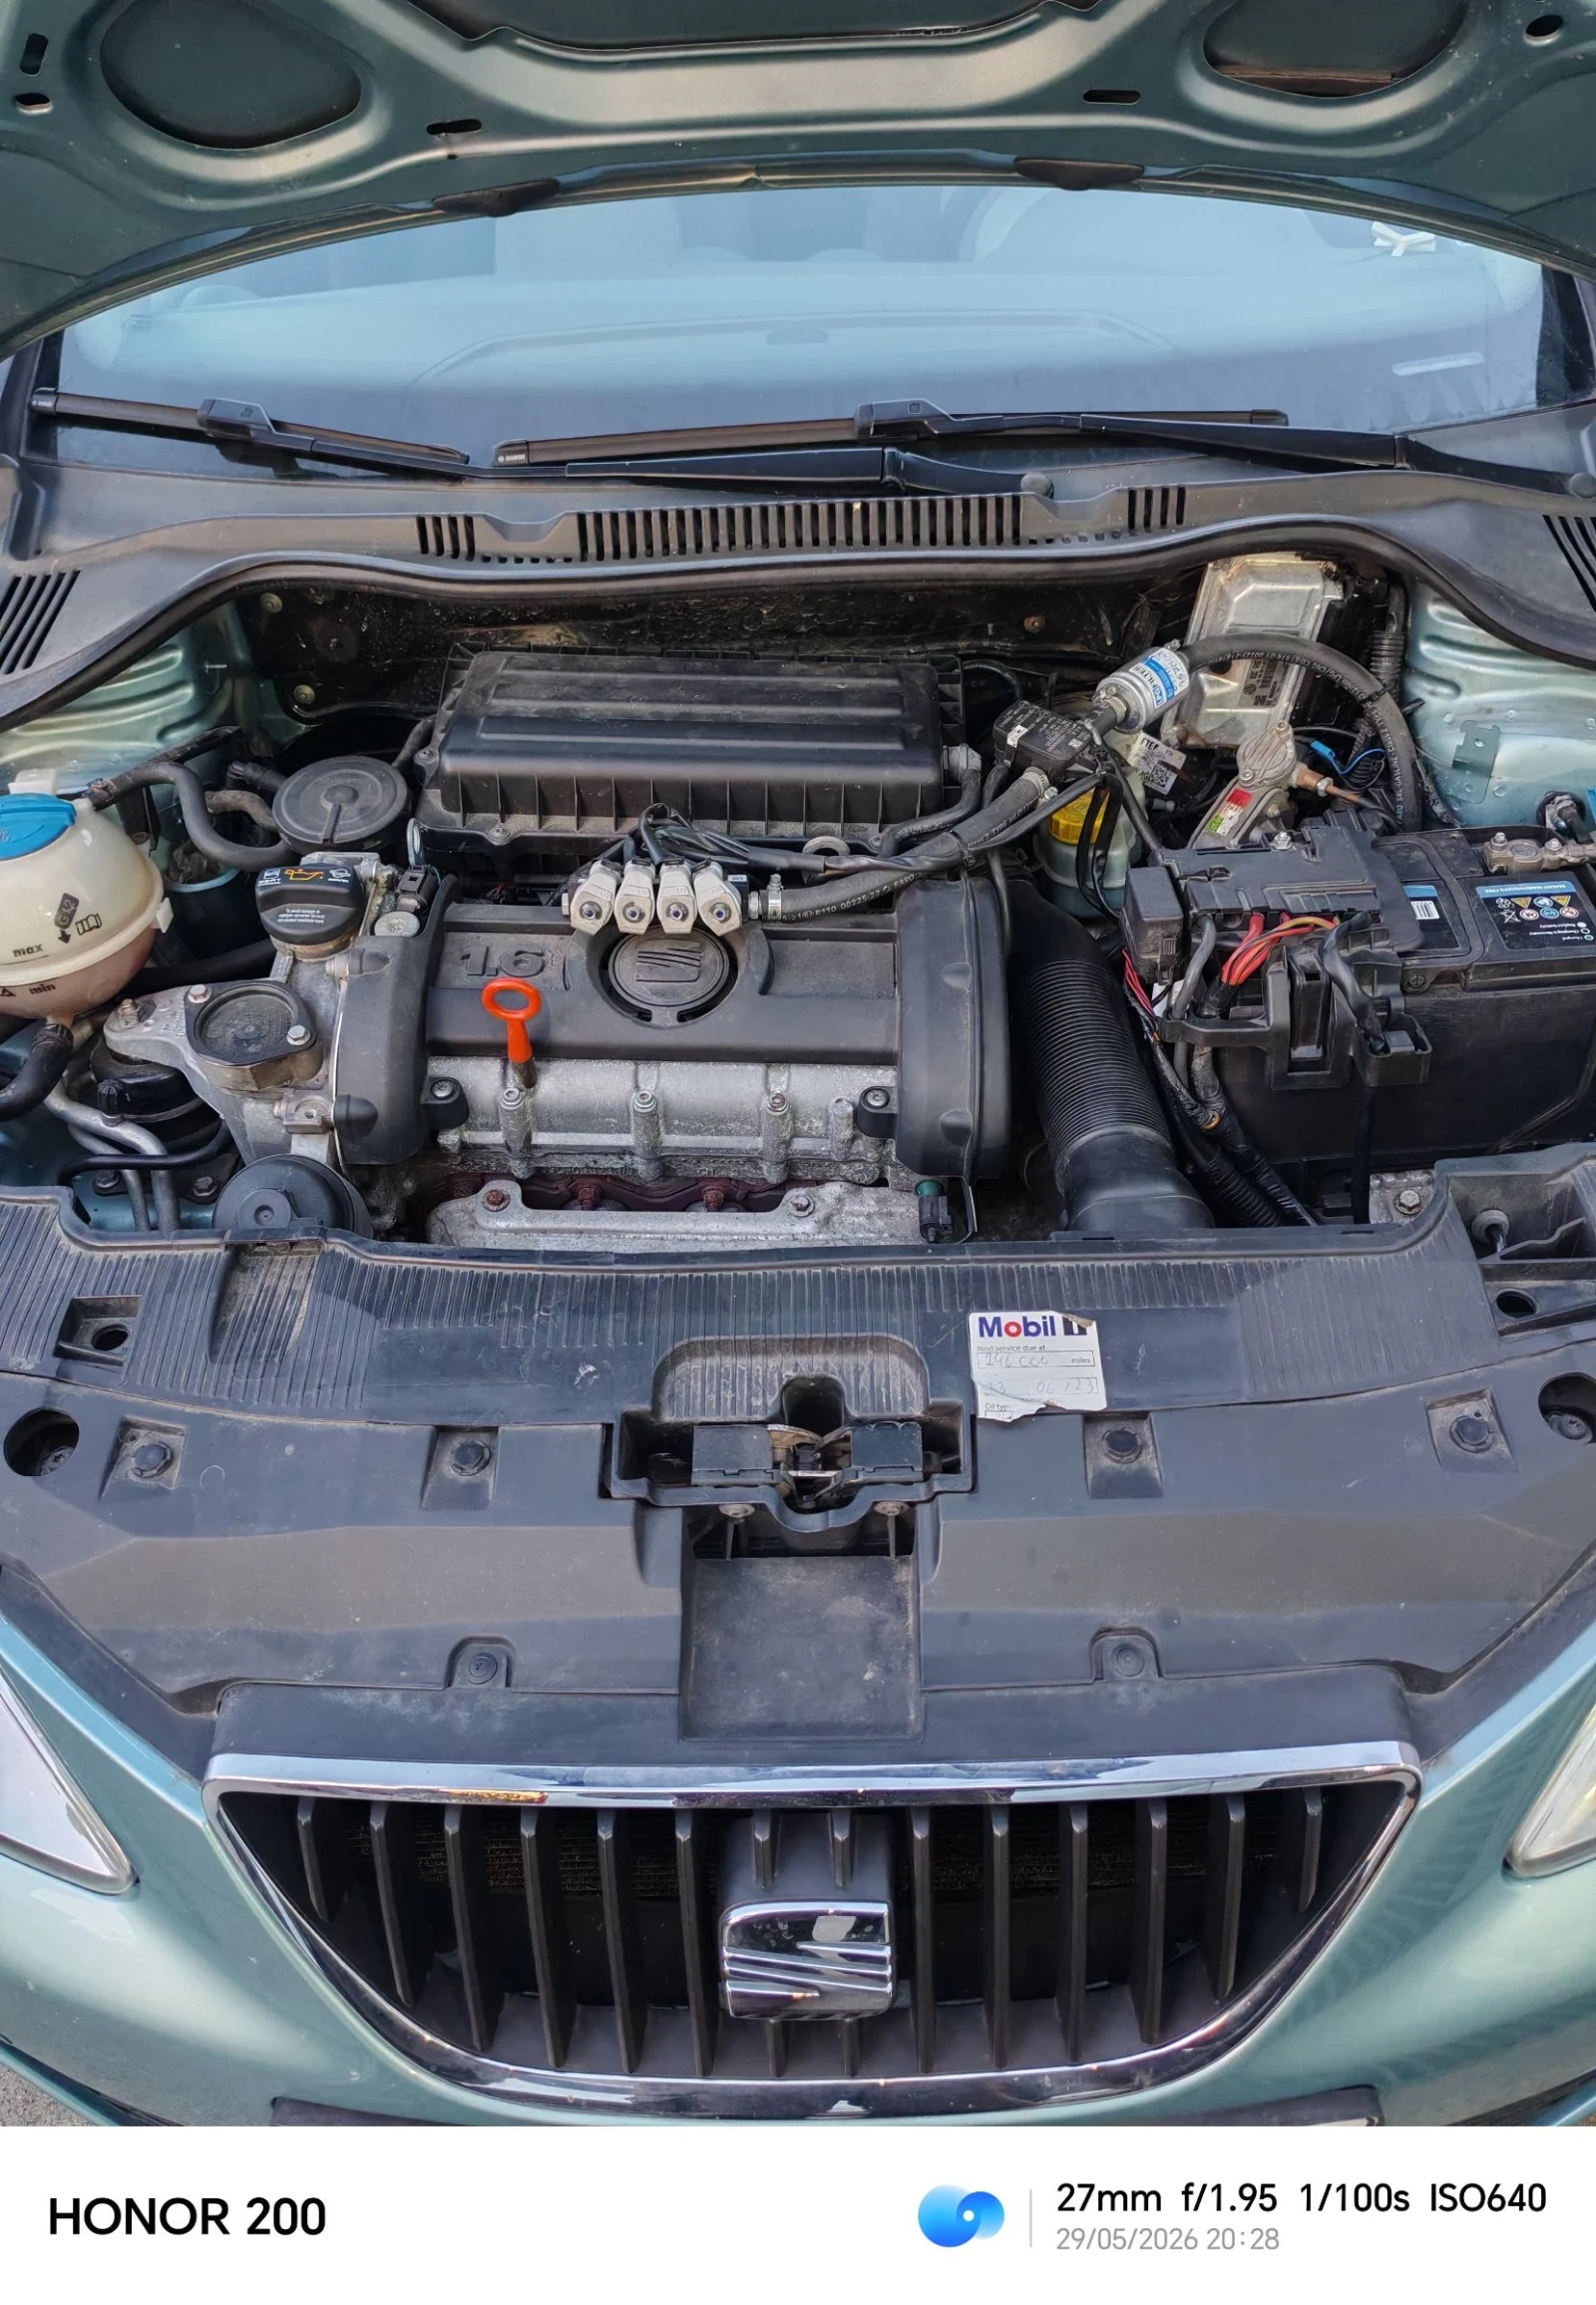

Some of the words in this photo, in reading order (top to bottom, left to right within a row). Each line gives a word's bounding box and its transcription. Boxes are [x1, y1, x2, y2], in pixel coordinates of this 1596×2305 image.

[12, 943, 45, 958] max
[461, 946, 546, 978] 1.6
[29, 983, 57, 995] min
[979, 1316, 1057, 1339] Mobil
[997, 1403, 1010, 1412] typ
